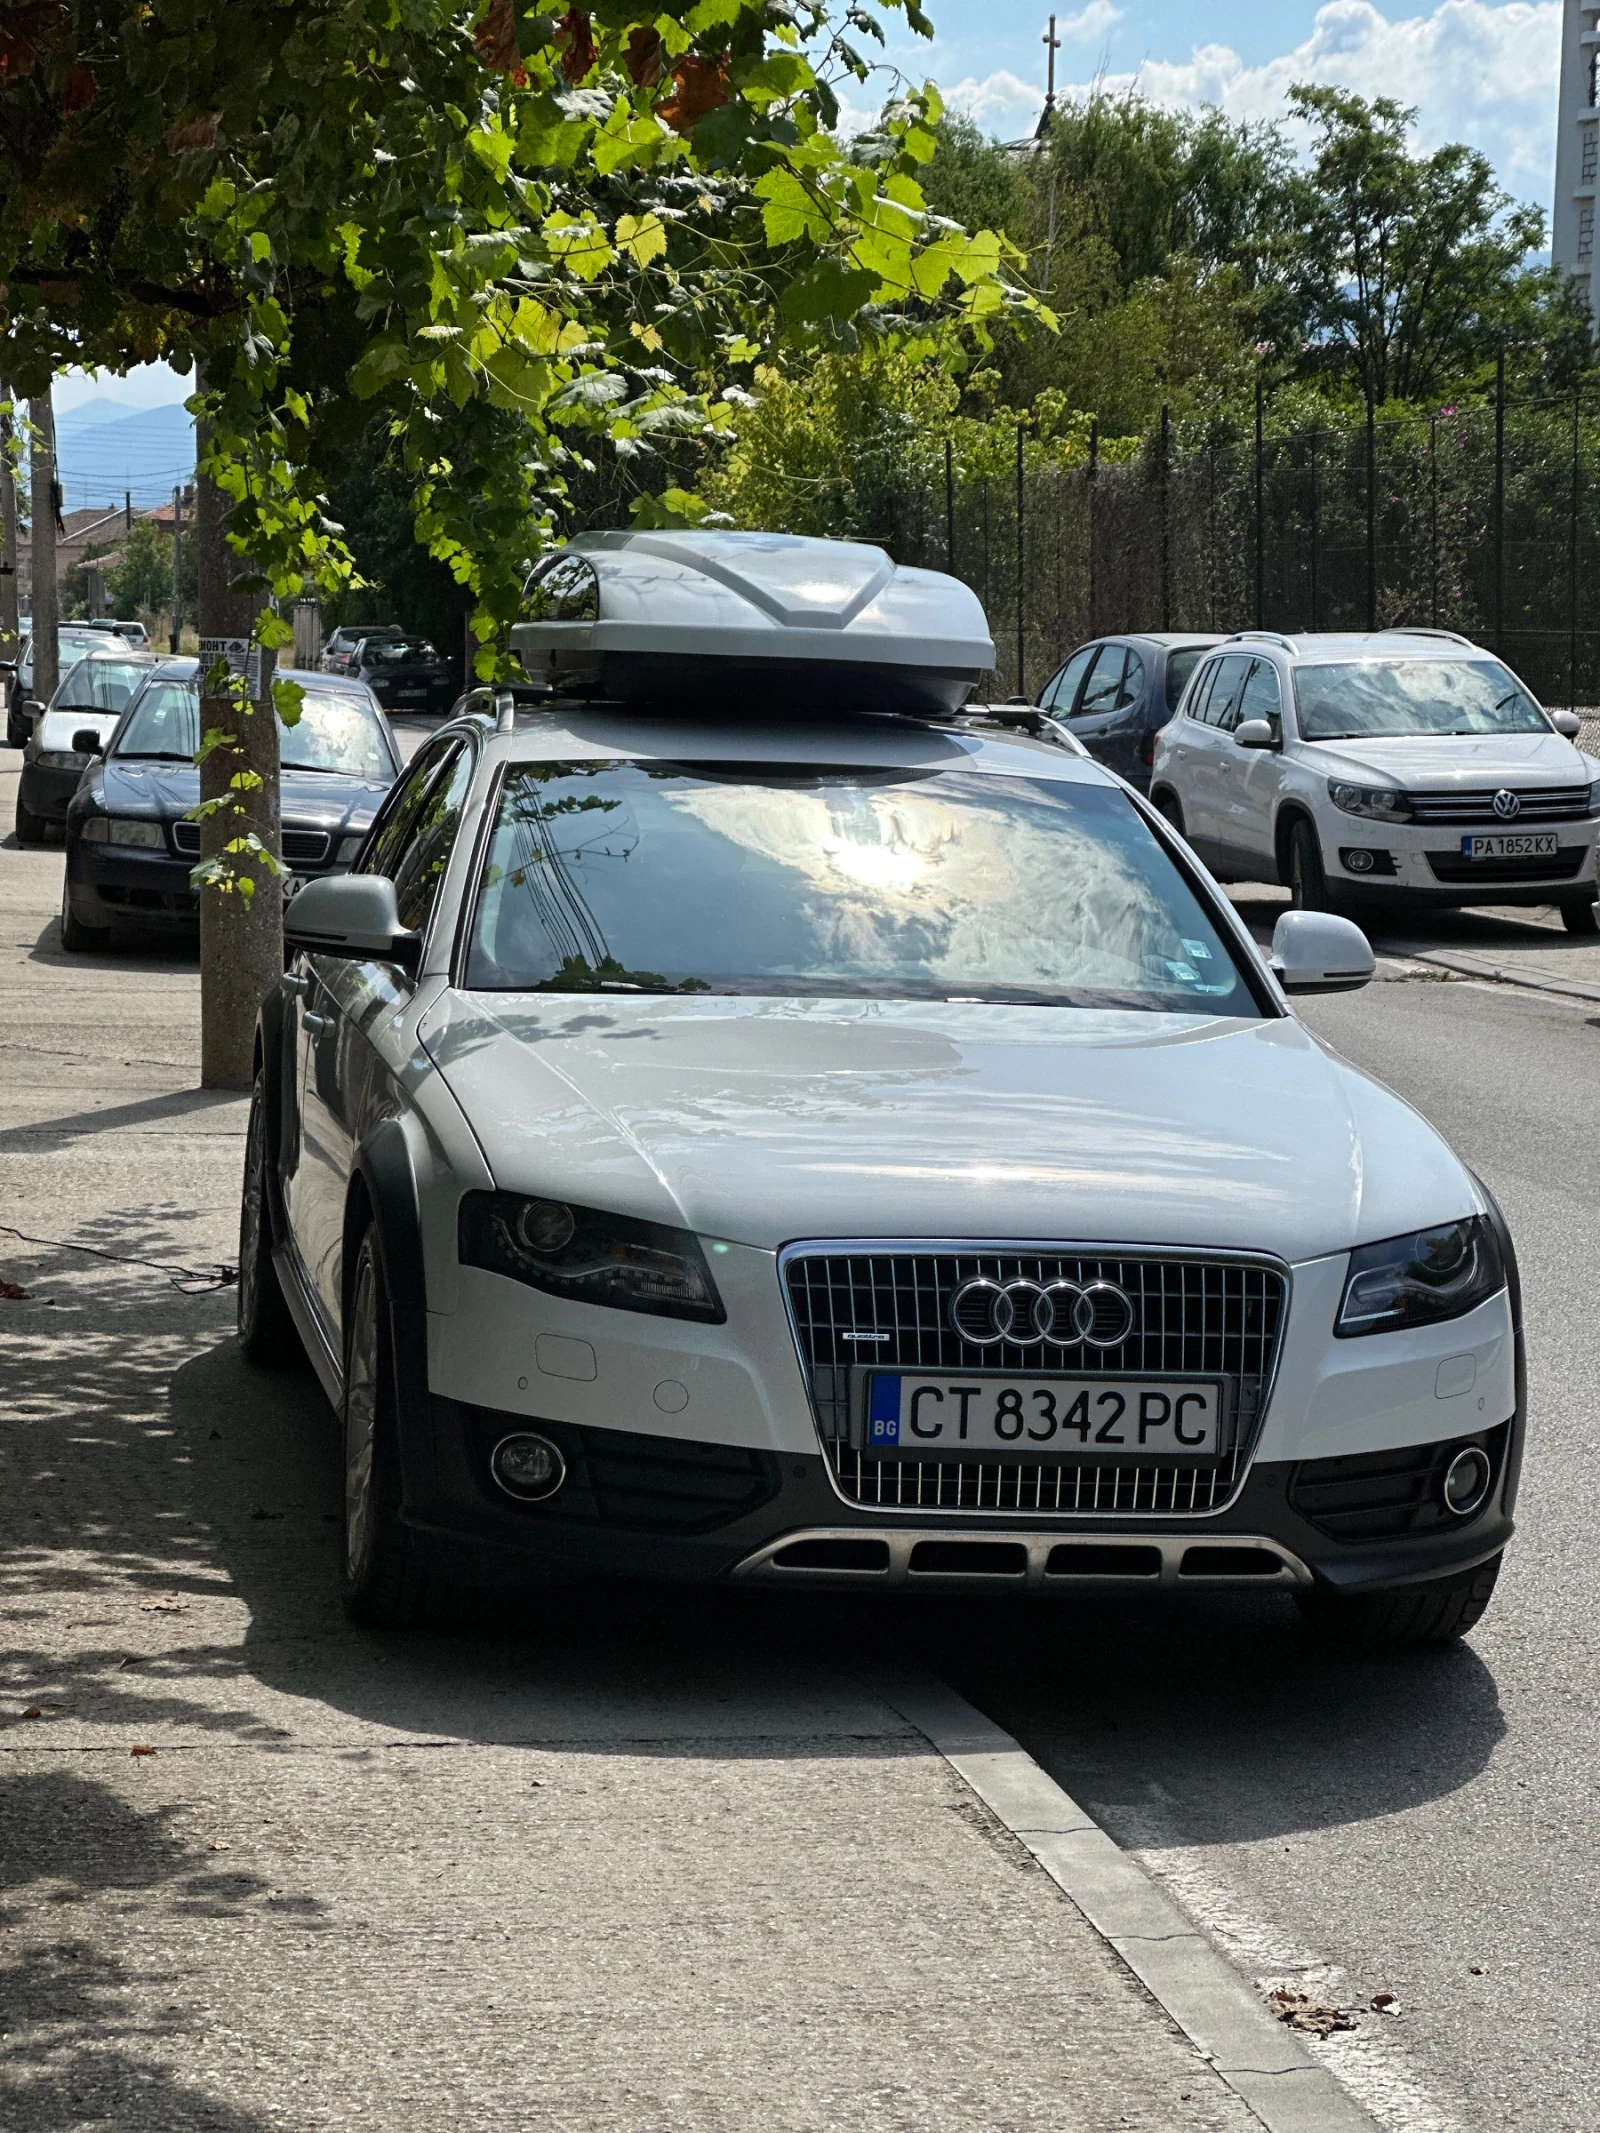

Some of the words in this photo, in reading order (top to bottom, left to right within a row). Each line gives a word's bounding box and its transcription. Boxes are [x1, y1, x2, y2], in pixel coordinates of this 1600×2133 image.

[1474, 839, 1494, 855] PA
[1498, 837, 1533, 854] 1852
[1535, 836, 1554, 853] KX
[874, 1419, 897, 1436] BG
[910, 1386, 981, 1439] CT
[995, 1388, 1126, 1443] 8342
[1138, 1391, 1207, 1445] PC
